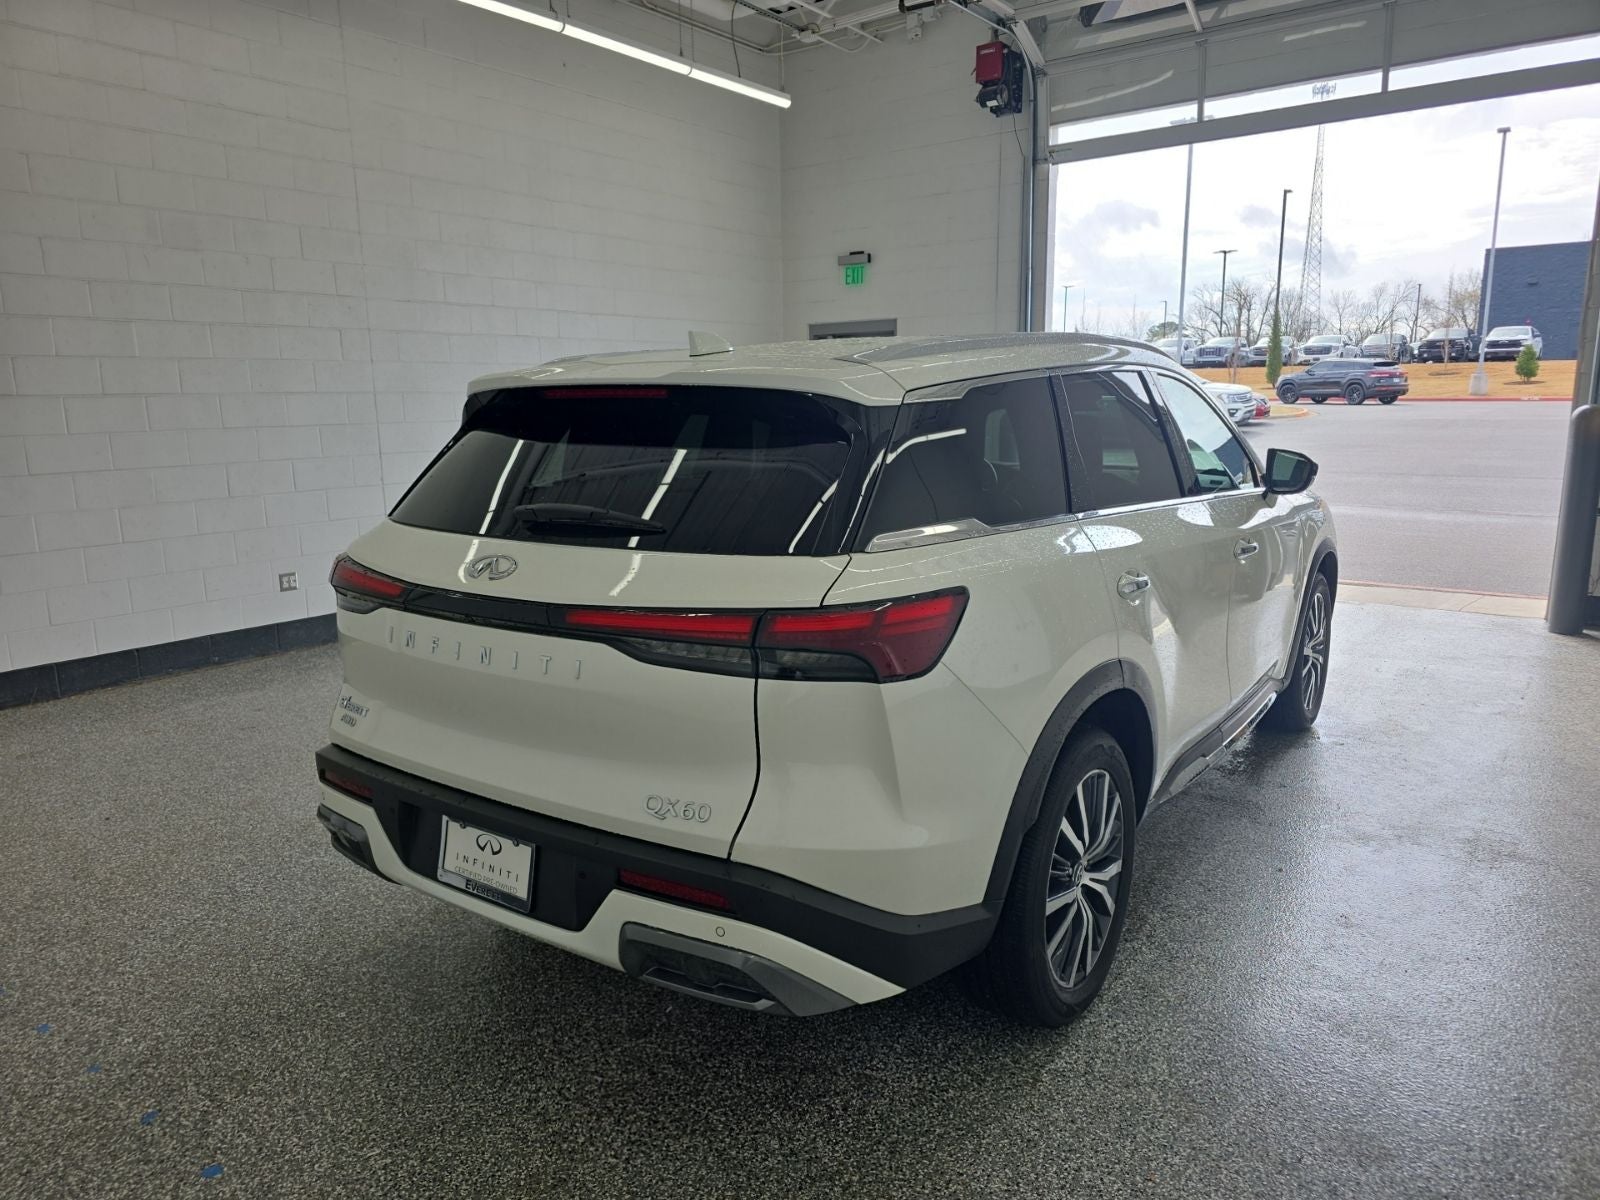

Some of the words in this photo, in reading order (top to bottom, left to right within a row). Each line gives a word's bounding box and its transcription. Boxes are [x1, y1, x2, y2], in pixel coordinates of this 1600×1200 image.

[845, 265, 865, 285] EXIT
[389, 626, 583, 680] INFINITI
[643, 794, 712, 823] QX60
[454, 865, 483, 881] CERTIFIED
[455, 852, 519, 882] INFINITI
